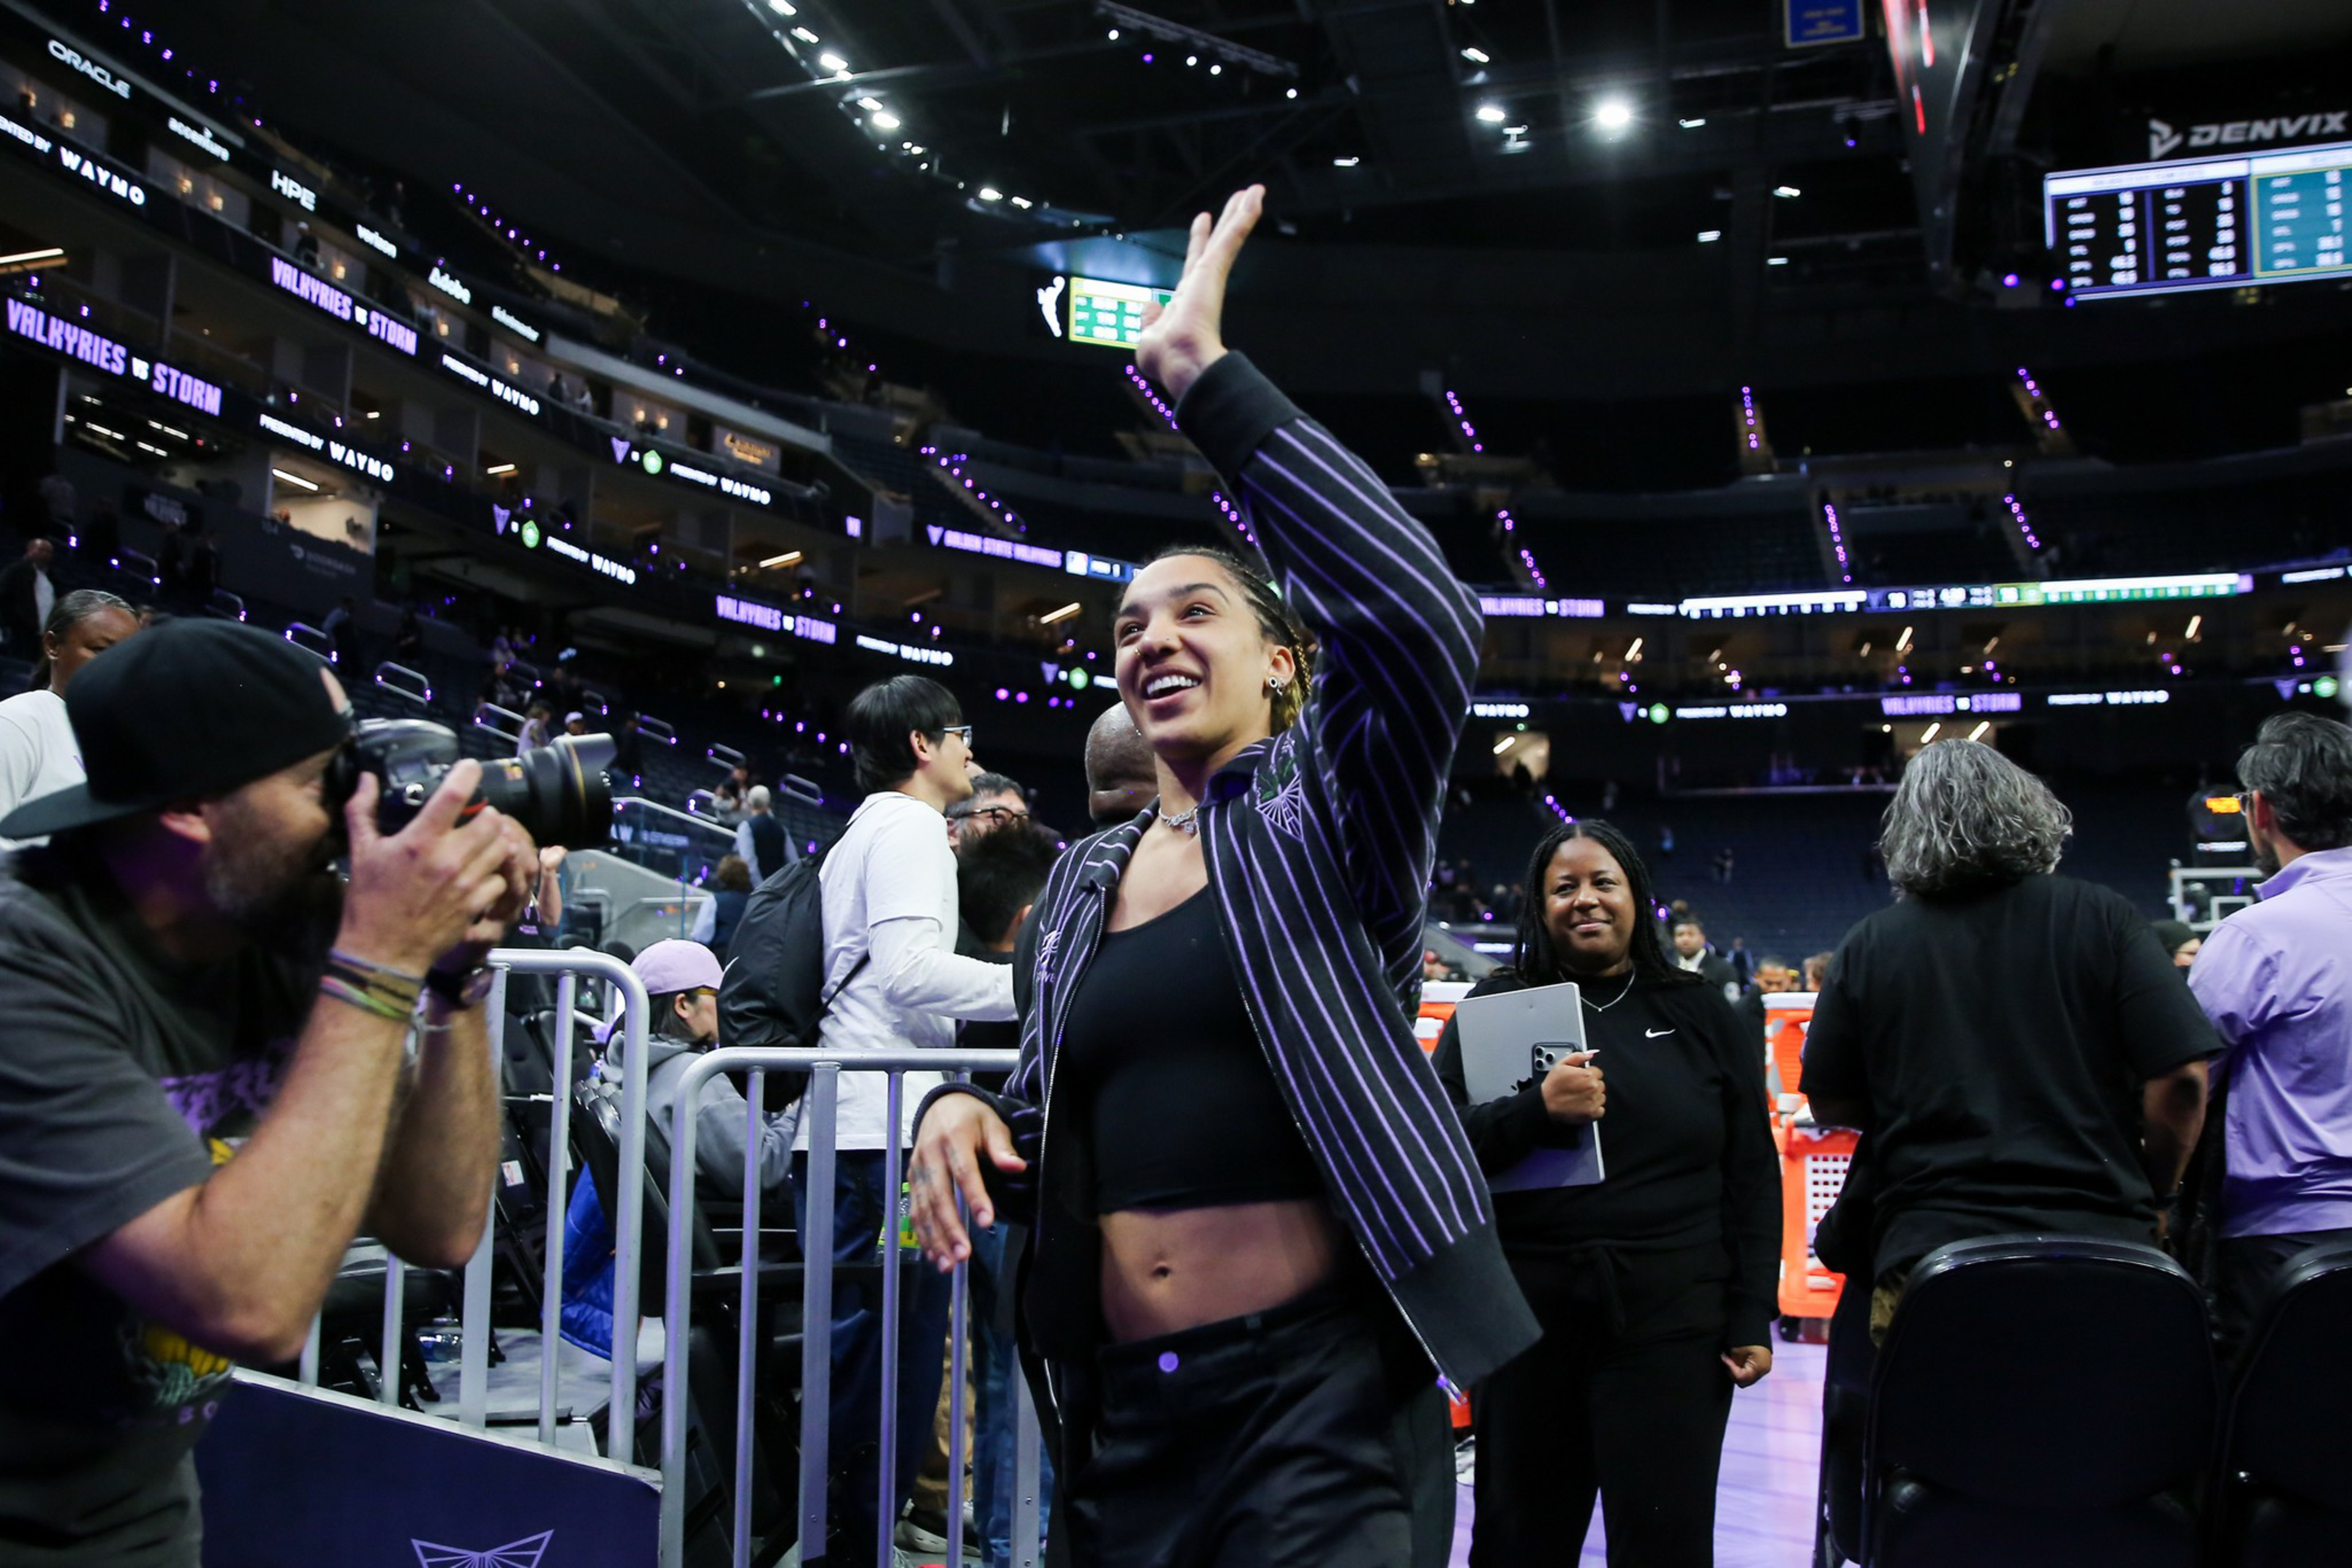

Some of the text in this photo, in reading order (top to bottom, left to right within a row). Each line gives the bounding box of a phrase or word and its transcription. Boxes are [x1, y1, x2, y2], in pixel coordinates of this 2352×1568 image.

[48, 40, 130, 98] ORACLE
[168, 117, 229, 161] accenture
[2188, 111, 2349, 148] DENVIX
[60, 146, 145, 205] WAYMO
[272, 170, 316, 211] HPE
[357, 224, 396, 258] verizon
[273, 256, 352, 320] VALKYRIES
[369, 311, 417, 355] STORM
[429, 267, 471, 304] Adobe
[7, 298, 222, 416] VALKYRIES VS STORM
[492, 379, 539, 415] WAYMO
[330, 441, 393, 481] WAYMO
[720, 477, 771, 504] WAYMO
[592, 554, 635, 584] WAYMO
[716, 595, 781, 631] VALKYRIES
[795, 616, 836, 644] STORM
[899, 645, 953, 666] WAYMO
